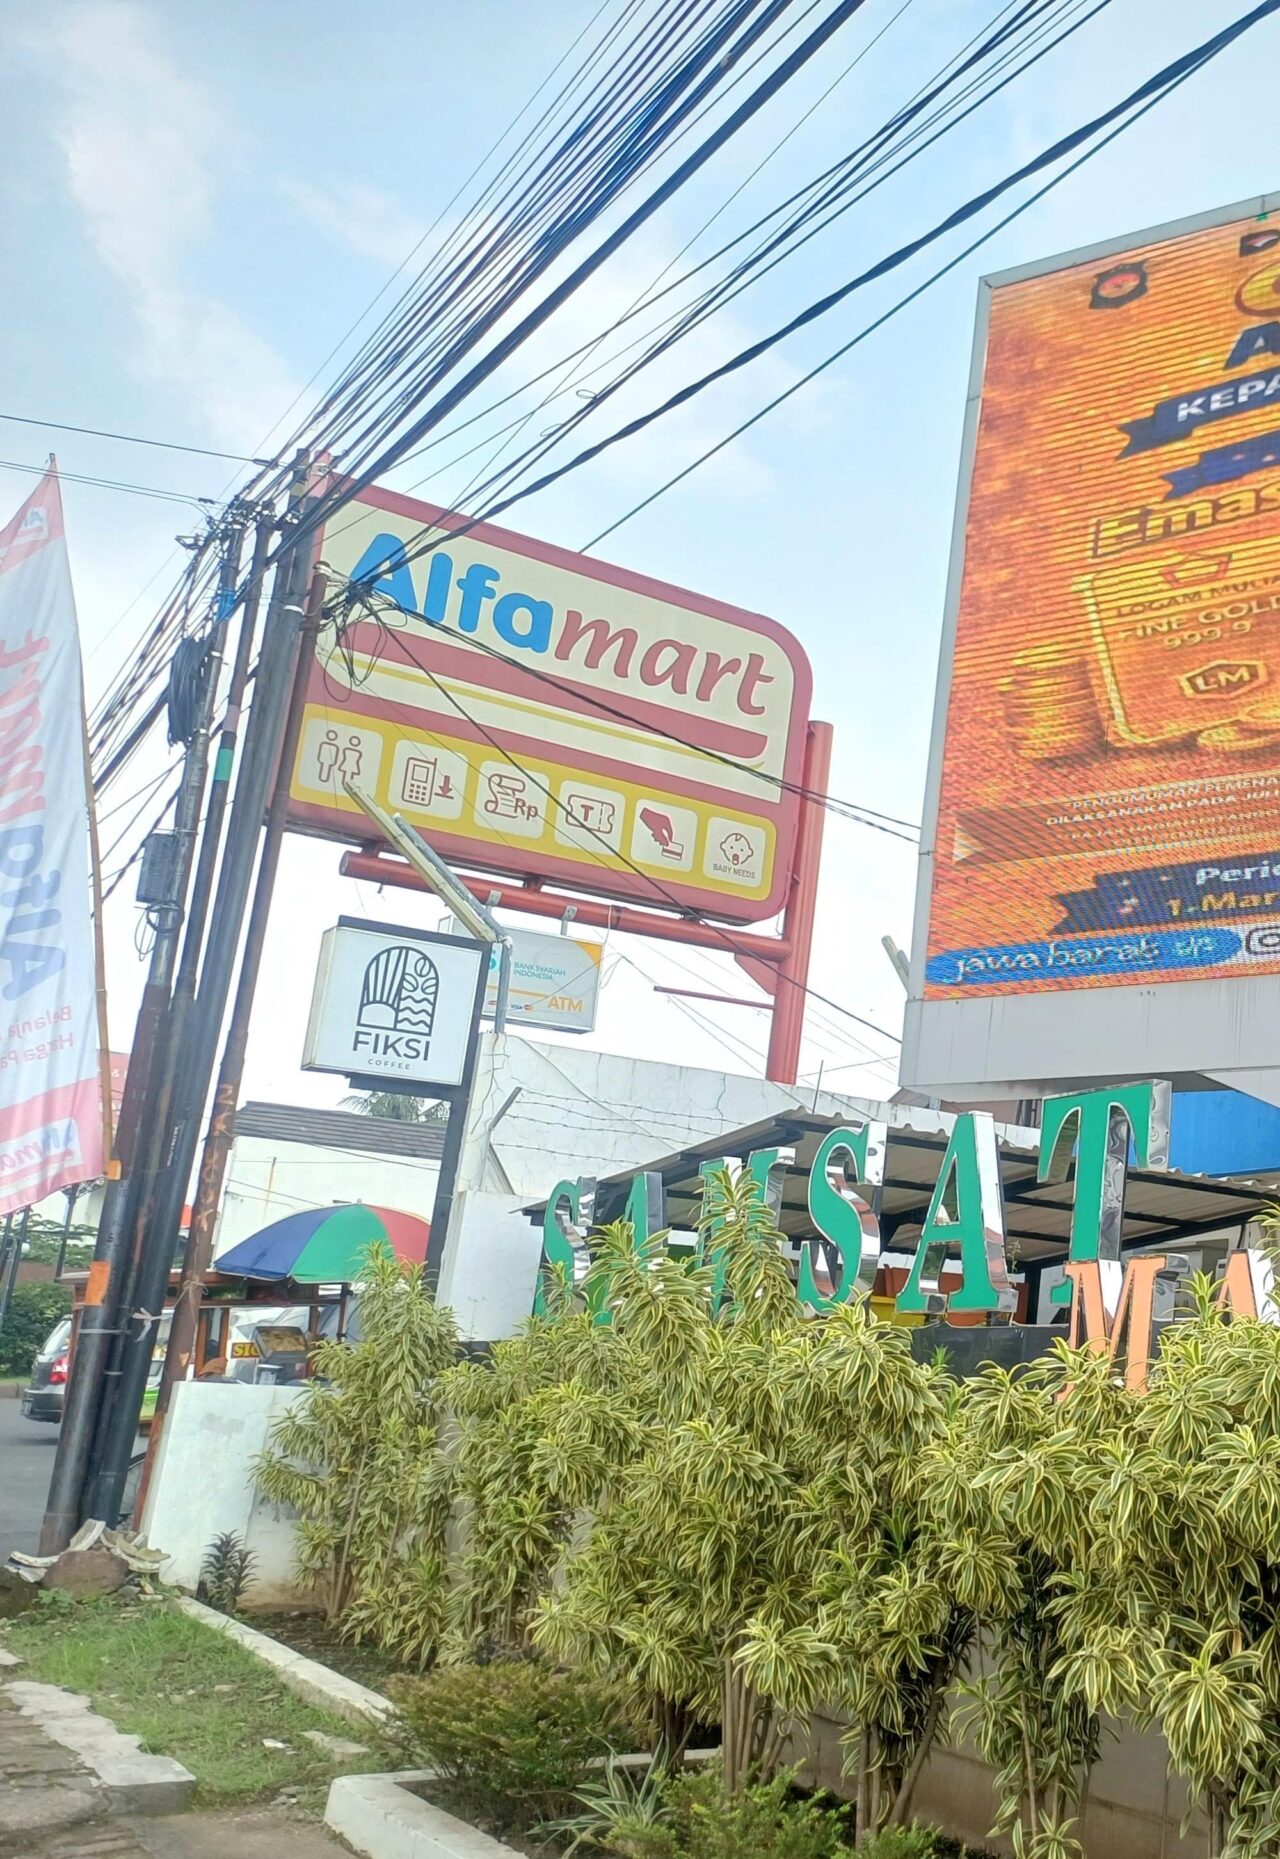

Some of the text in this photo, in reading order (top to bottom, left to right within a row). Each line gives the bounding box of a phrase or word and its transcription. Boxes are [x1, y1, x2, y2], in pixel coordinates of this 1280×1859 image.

[350, 533, 775, 716] Alfamart
[1118, 616, 1187, 640] FINE
[513, 798, 539, 821] Rp
[1186, 795, 1237, 808] PADA
[713, 863, 756, 879] BABY NEEDS
[513, 969, 554, 981] INDONESIA
[514, 961, 566, 977] BANK SYARIAH
[547, 996, 583, 1013] ATM
[352, 1030, 431, 1061] FIKSI
[367, 1058, 411, 1070] COFFEE
